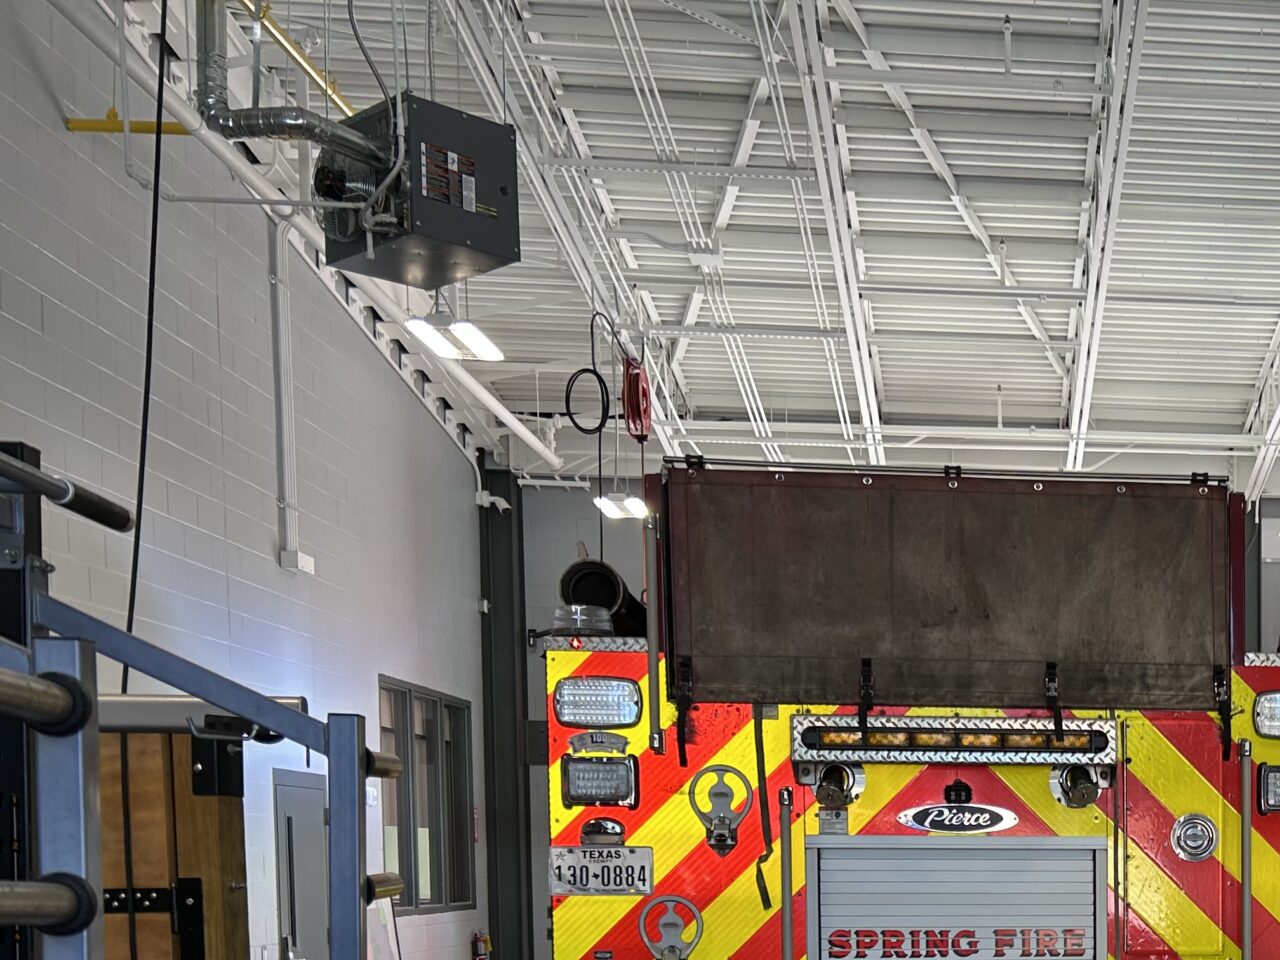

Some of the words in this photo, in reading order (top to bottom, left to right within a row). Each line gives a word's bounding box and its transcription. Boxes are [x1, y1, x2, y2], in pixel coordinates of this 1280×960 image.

[924, 807, 991, 828] Pierce
[581, 850, 621, 859] TEXAS
[828, 929, 980, 959] SPRING
[992, 928, 1086, 958] FIRE
